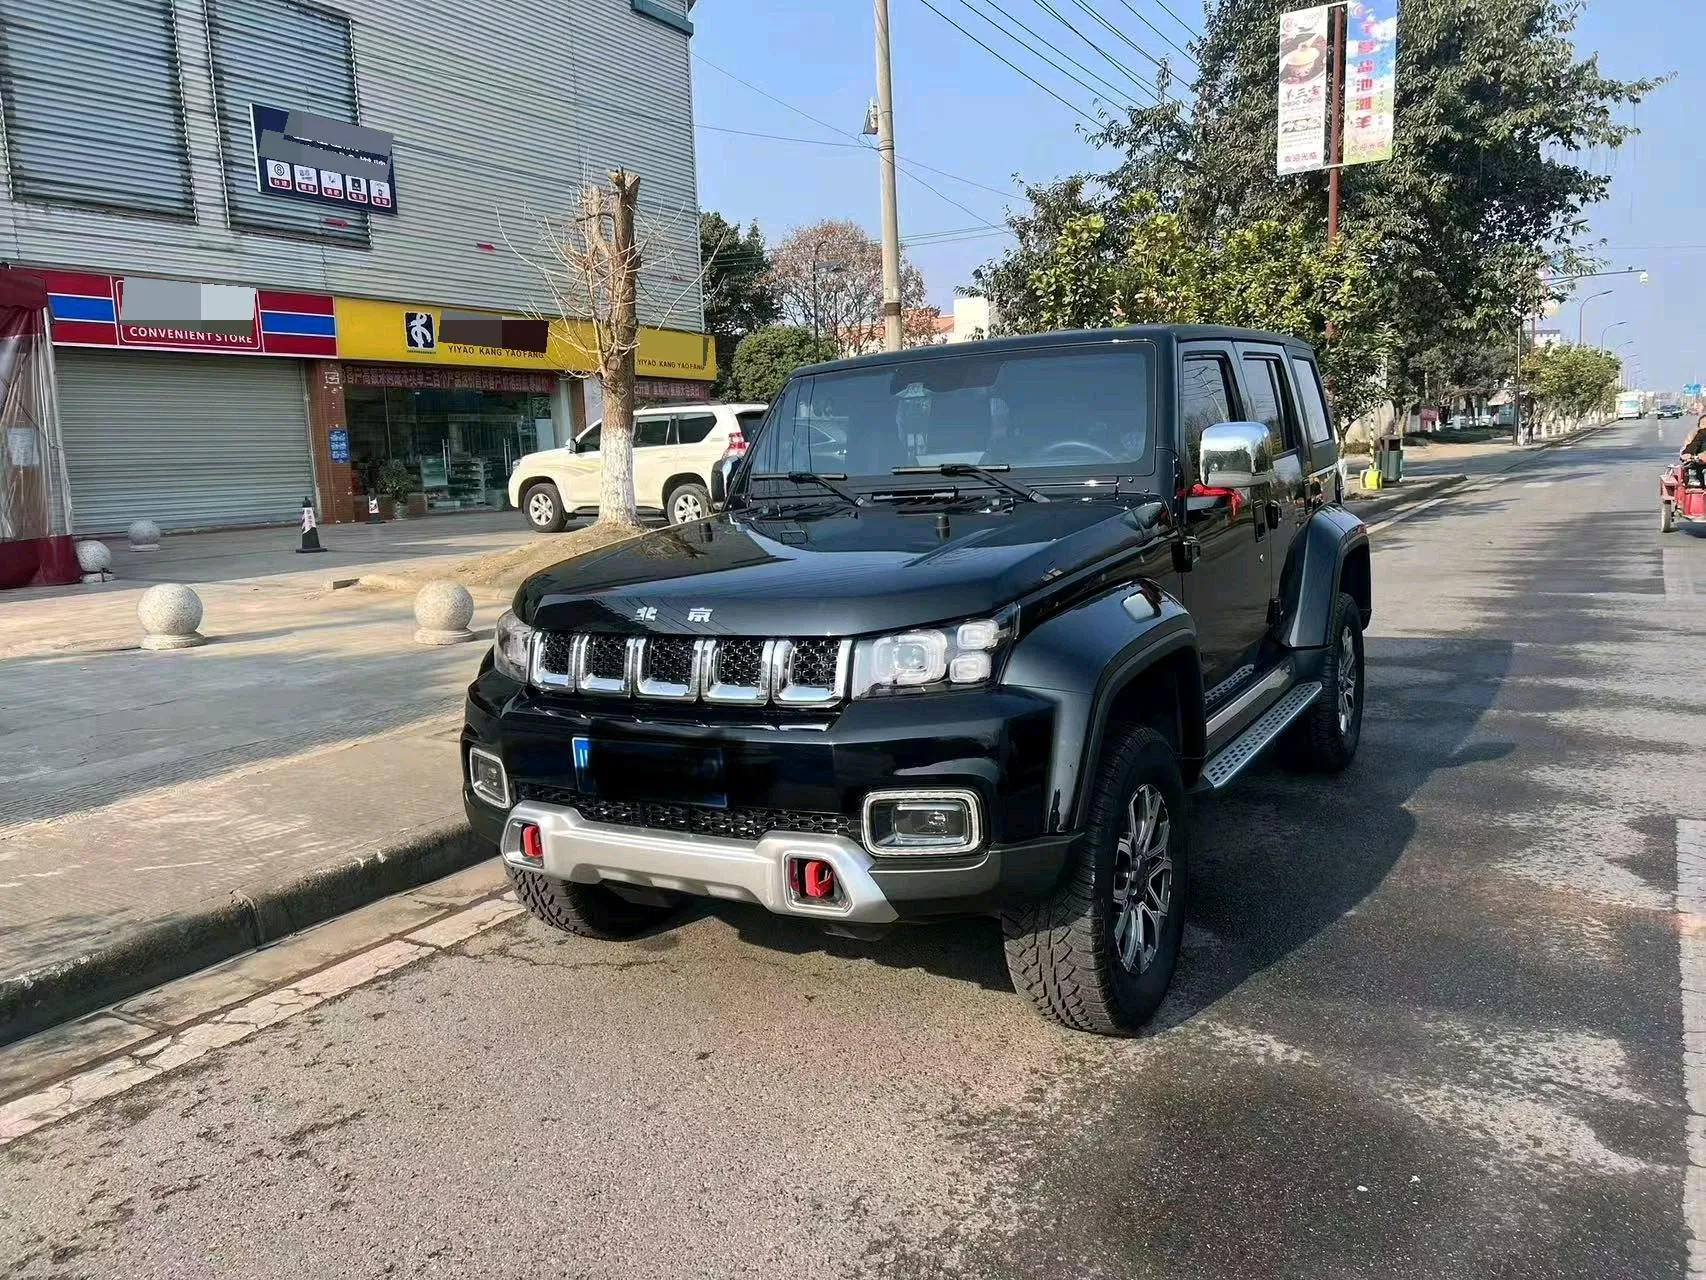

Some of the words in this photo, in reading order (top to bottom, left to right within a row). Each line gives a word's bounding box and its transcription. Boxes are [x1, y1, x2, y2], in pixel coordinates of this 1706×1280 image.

[130, 327, 212, 341] CONVENIENT
[448, 345, 474, 355] YIYAO
[479, 347, 502, 356] KANG
[638, 359, 656, 367] YIYAO
[659, 360, 676, 368] KANG
[634, 607, 713, 623] 北京
